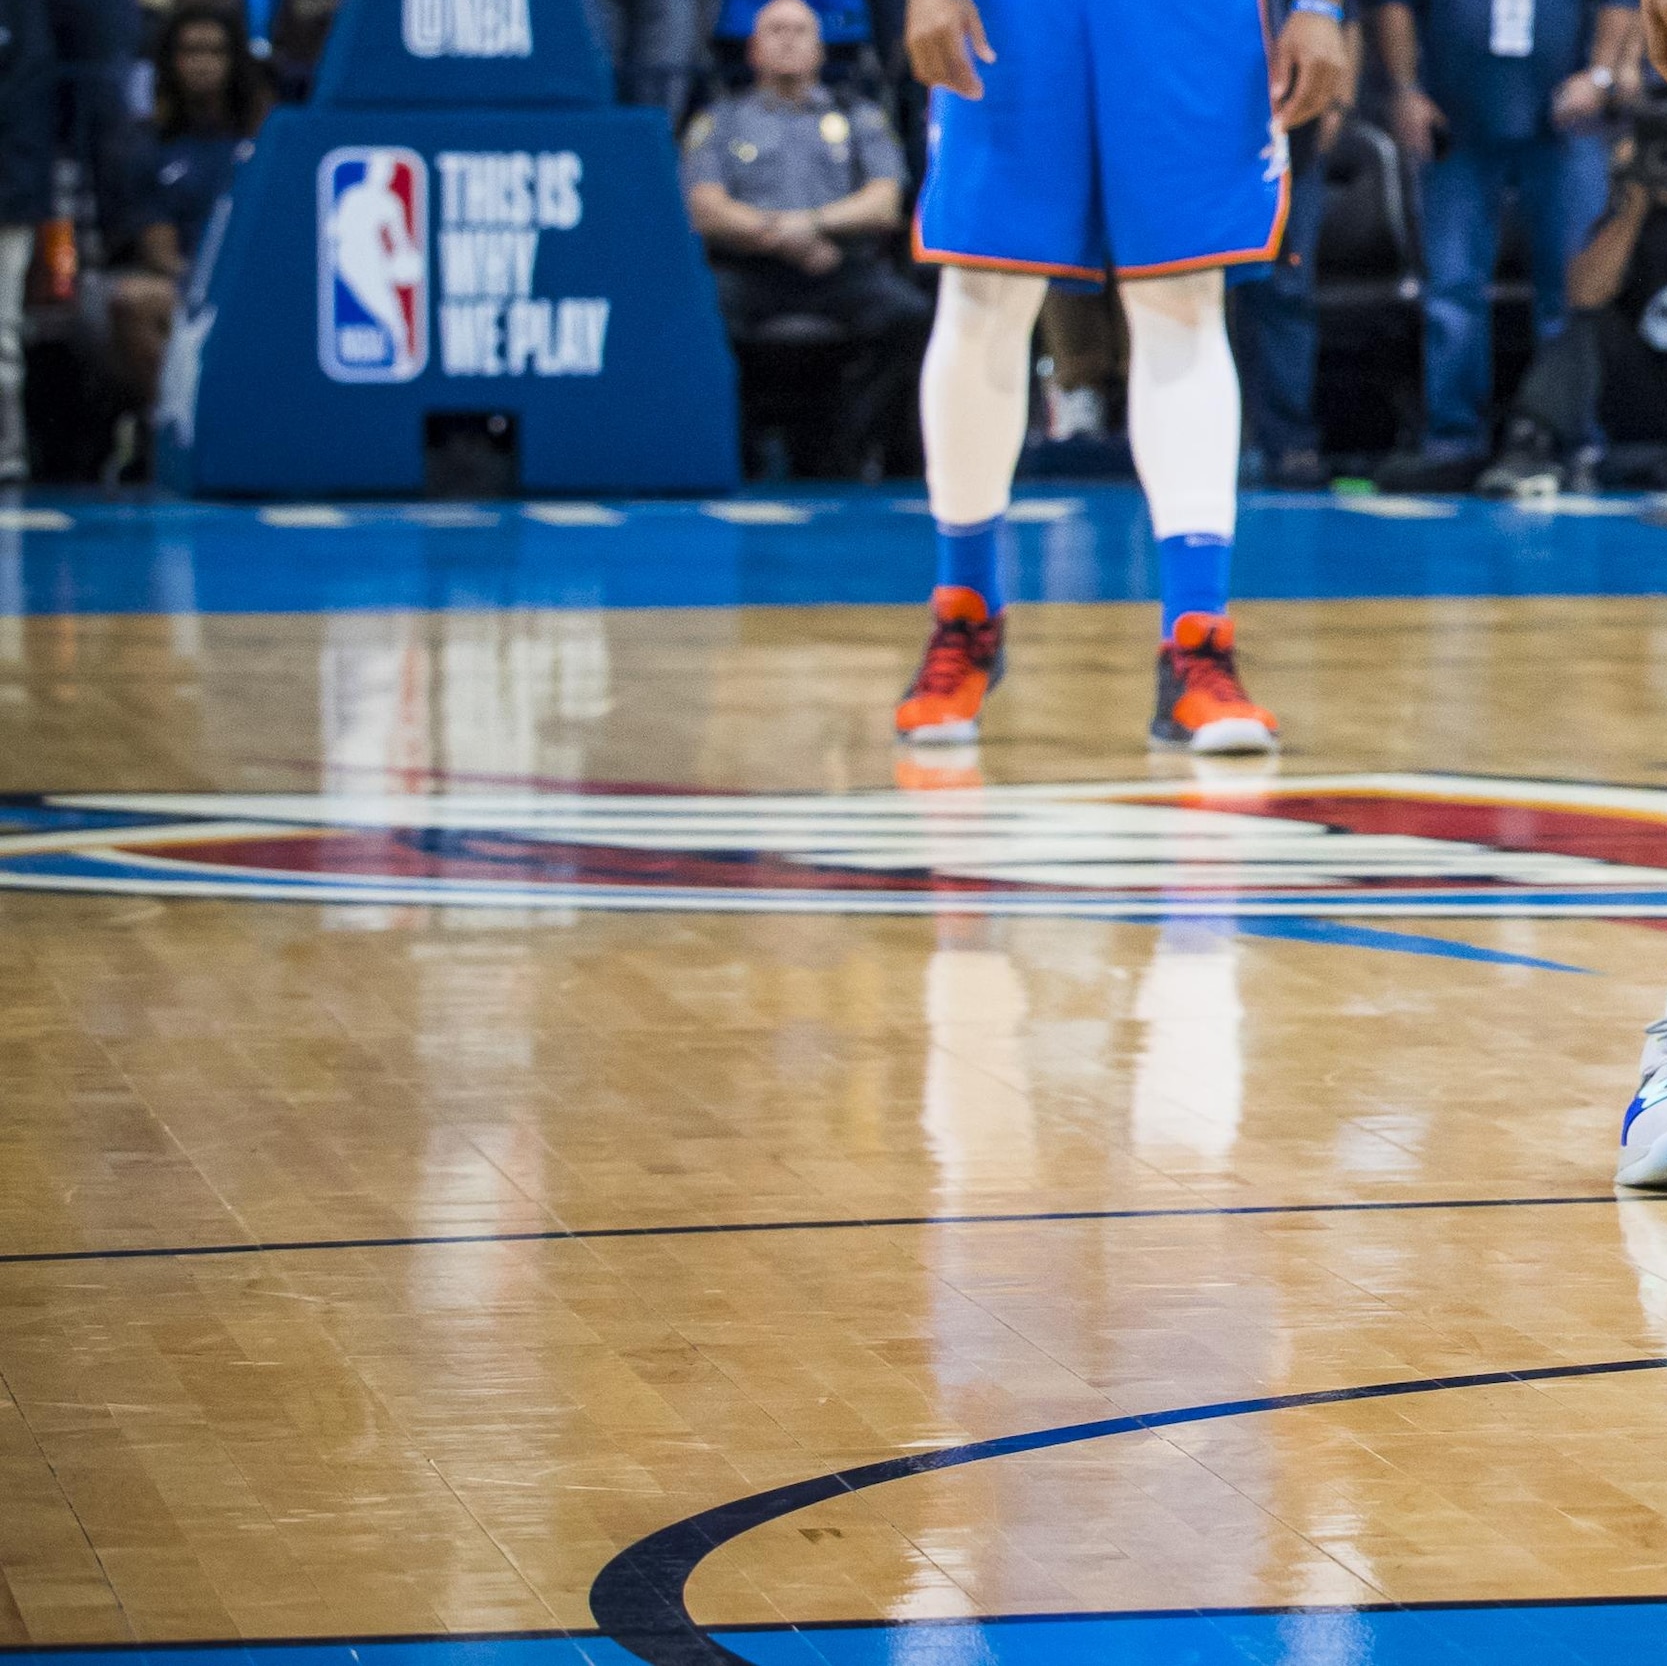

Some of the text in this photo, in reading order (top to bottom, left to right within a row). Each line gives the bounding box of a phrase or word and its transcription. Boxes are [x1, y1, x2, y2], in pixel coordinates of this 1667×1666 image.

[435, 150, 583, 229] THIS IS
[438, 231, 540, 298] WHY
[438, 297, 610, 377] WE PLAY
